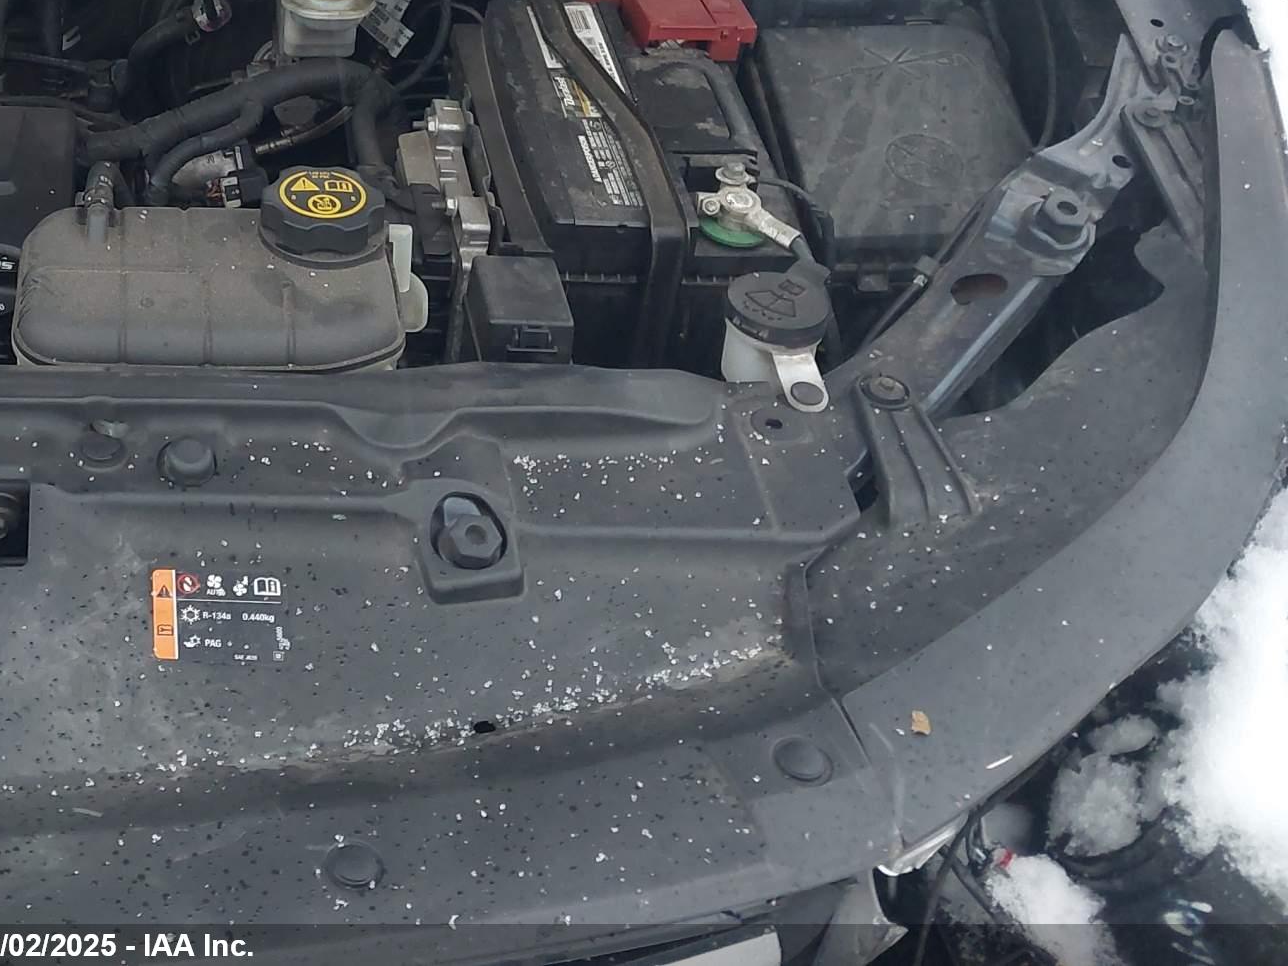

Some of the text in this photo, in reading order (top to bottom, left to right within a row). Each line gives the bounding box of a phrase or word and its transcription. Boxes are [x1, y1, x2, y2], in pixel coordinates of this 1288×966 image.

[202, 611, 275, 623] R-134a 0.440kg
[204, 638, 222, 648] PAG
